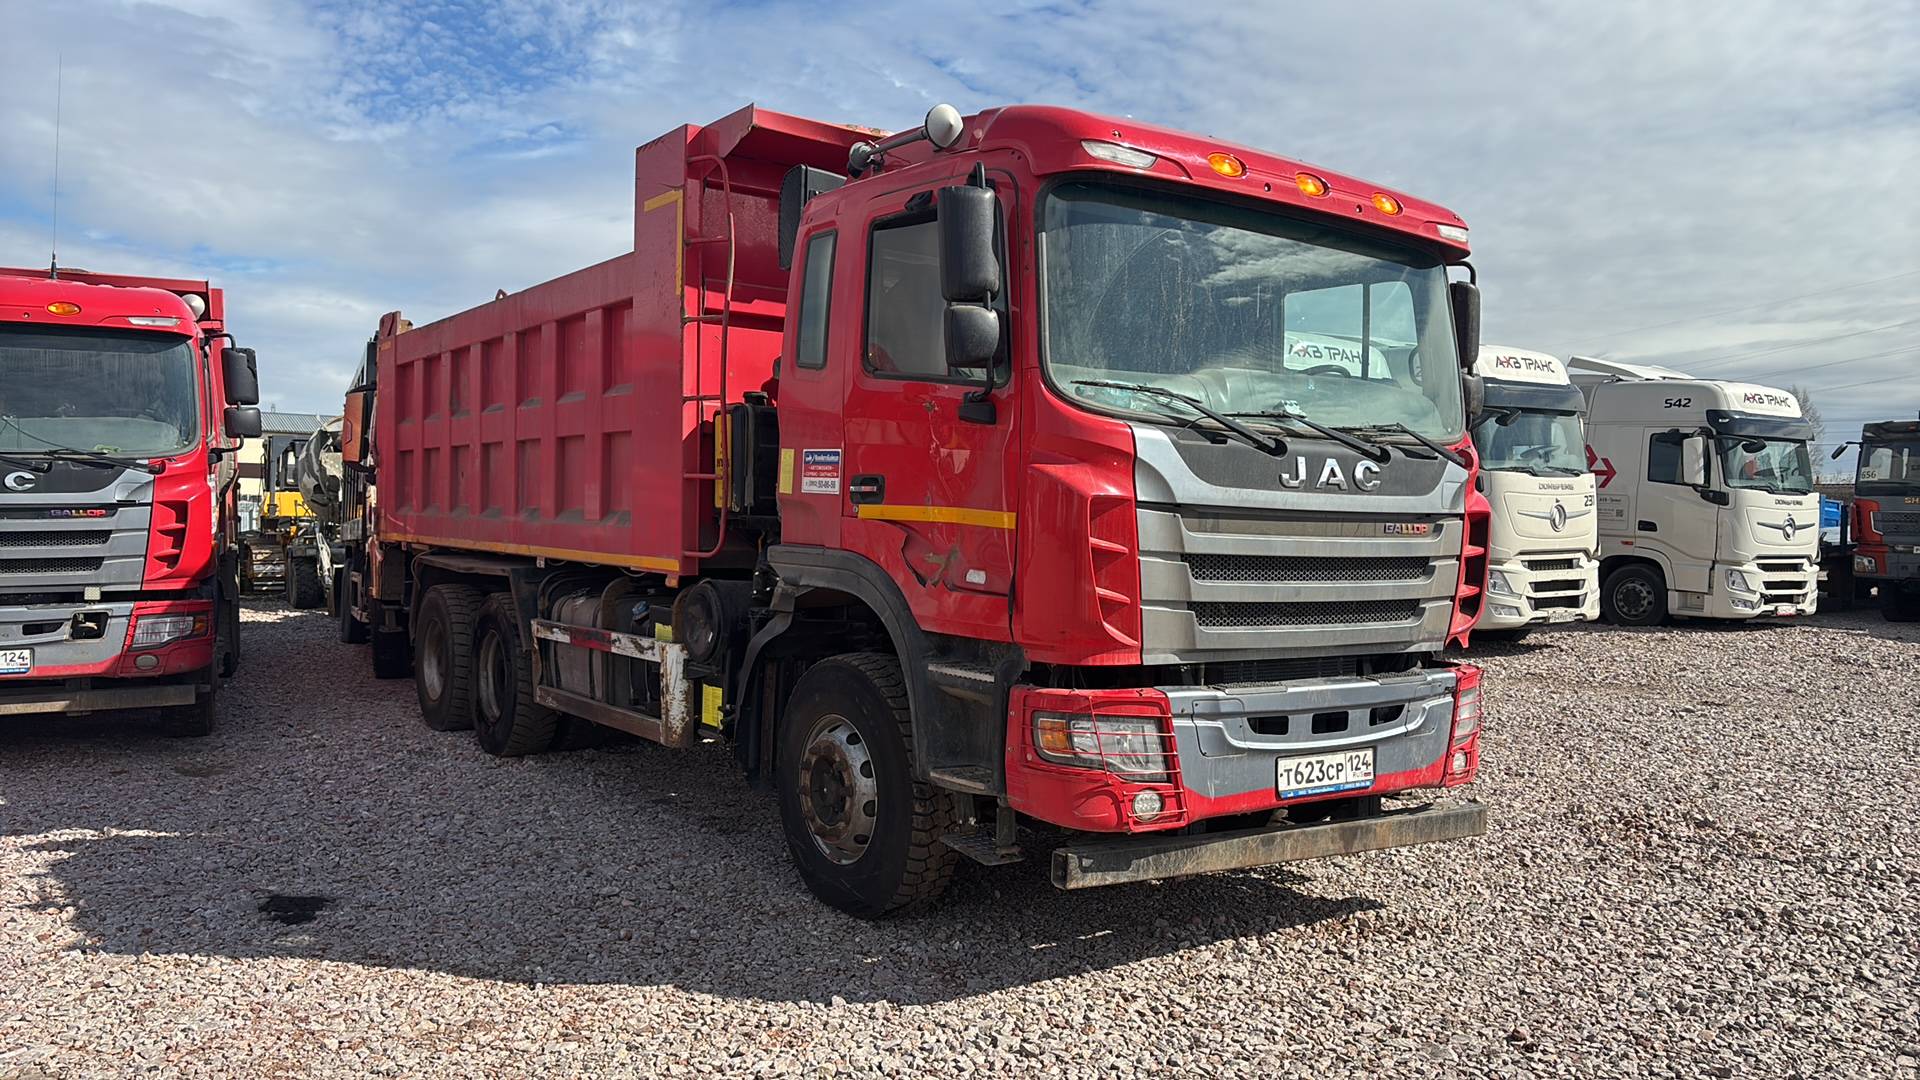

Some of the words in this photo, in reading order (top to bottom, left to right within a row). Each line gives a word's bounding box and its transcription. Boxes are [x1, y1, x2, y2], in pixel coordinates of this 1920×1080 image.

[1323, 346, 1362, 364] ТРАН
[1521, 357, 1555, 373] ТРАНС
[1764, 394, 1791, 408] ТРАНС
[1279, 456, 1381, 492] JAC
[1904, 496, 1920, 504] SH
[50, 509, 106, 517] GALLOP
[1384, 522, 1428, 535] GALLOP
[1, 651, 26, 663] 124
[1284, 759, 1344, 786] Т623СР
[1347, 753, 1370, 772] 124
